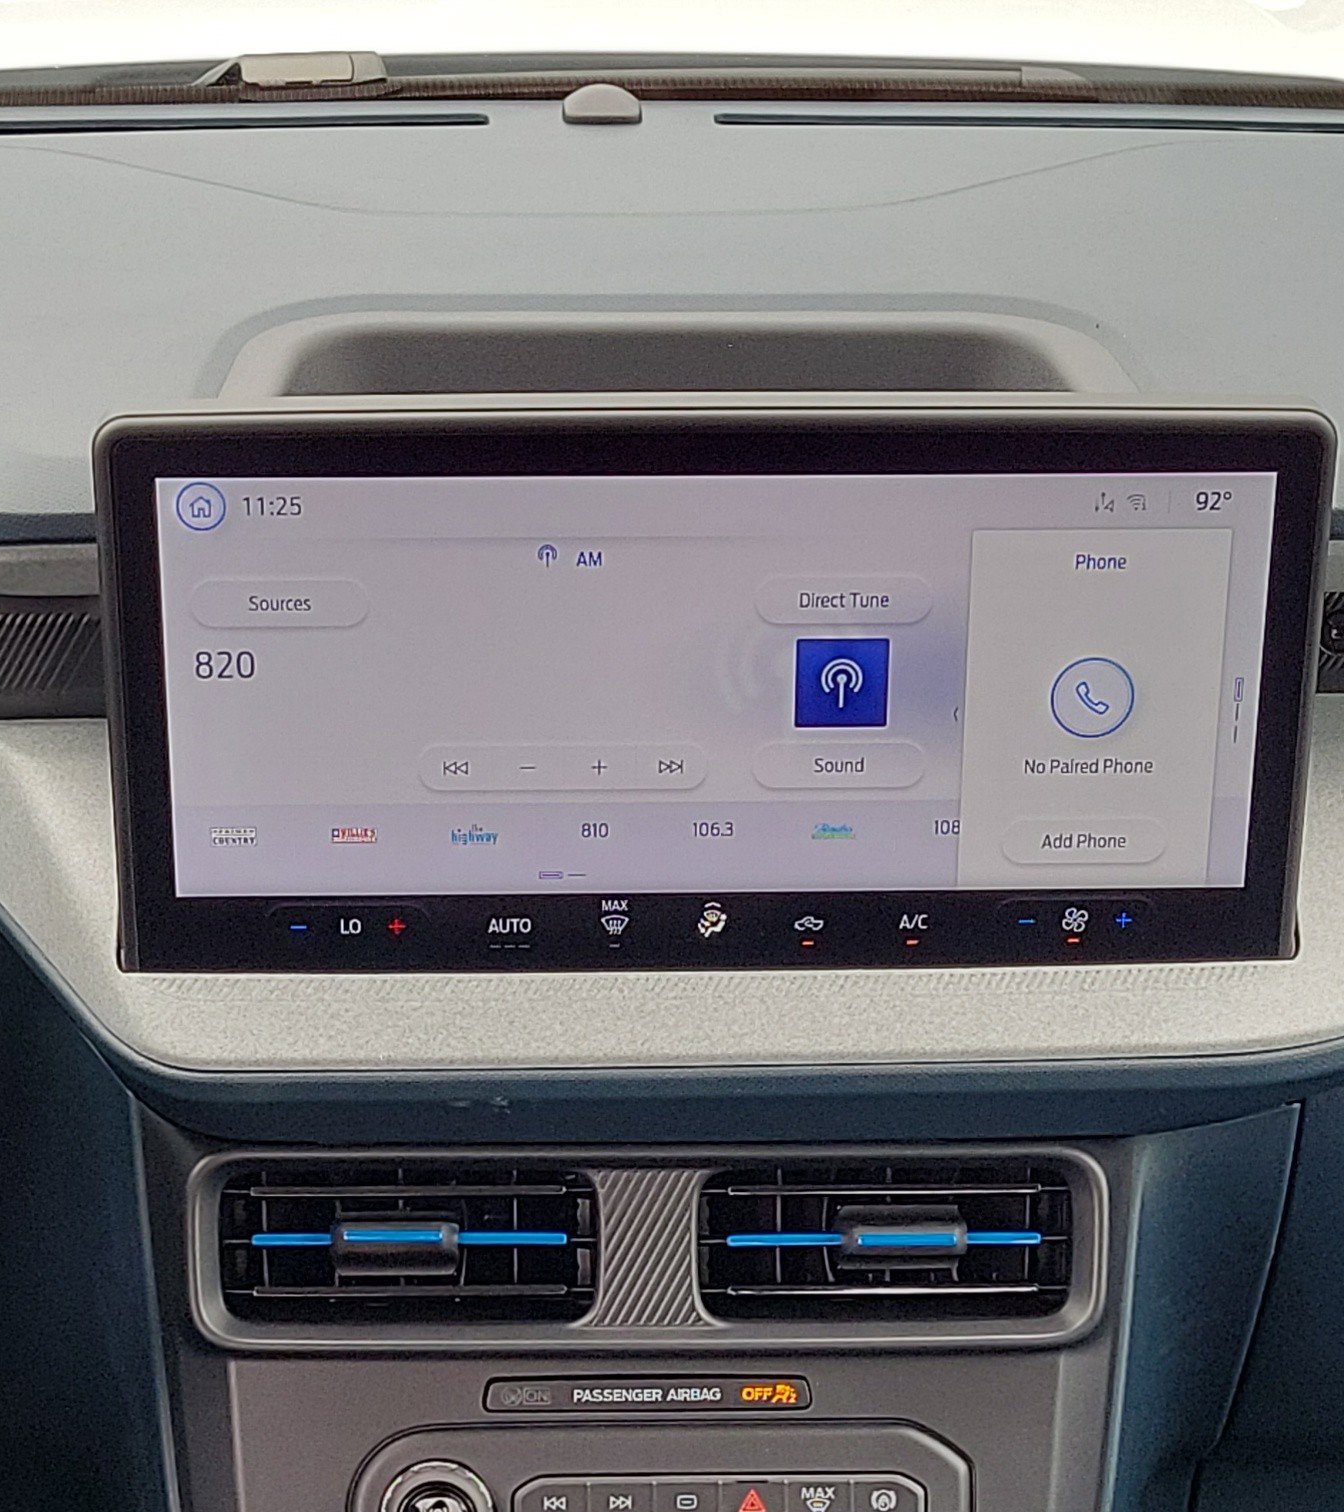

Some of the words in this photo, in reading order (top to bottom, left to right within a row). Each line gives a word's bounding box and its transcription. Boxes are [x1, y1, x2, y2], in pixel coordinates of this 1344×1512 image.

[243, 496, 303, 517] 11:25
[1196, 491, 1232, 511] 92°
[576, 552, 603, 567] AM
[1075, 554, 1126, 570] Phone
[248, 595, 311, 613] Sources
[799, 592, 845, 608] Direct
[849, 593, 890, 608] Tune
[195, 652, 255, 679] 820
[814, 757, 865, 774] Sound
[1024, 759, 1045, 774] No
[1049, 758, 1098, 774] Paired
[1103, 758, 1153, 774] Phone
[451, 829, 498, 845] highway
[581, 822, 609, 839] 810
[692, 822, 734, 838] 106.3
[1041, 834, 1070, 849] Add
[1075, 833, 1126, 849] Phone
[601, 900, 628, 912] MAX
[340, 919, 361, 935] LO
[488, 919, 532, 934] AUTO
[899, 914, 928, 931] A/C
[573, 1388, 663, 1403] PASSENGER
[666, 1388, 722, 1402] AIRBAG
[741, 1386, 772, 1401] OFF
[801, 1487, 835, 1500] MAX
